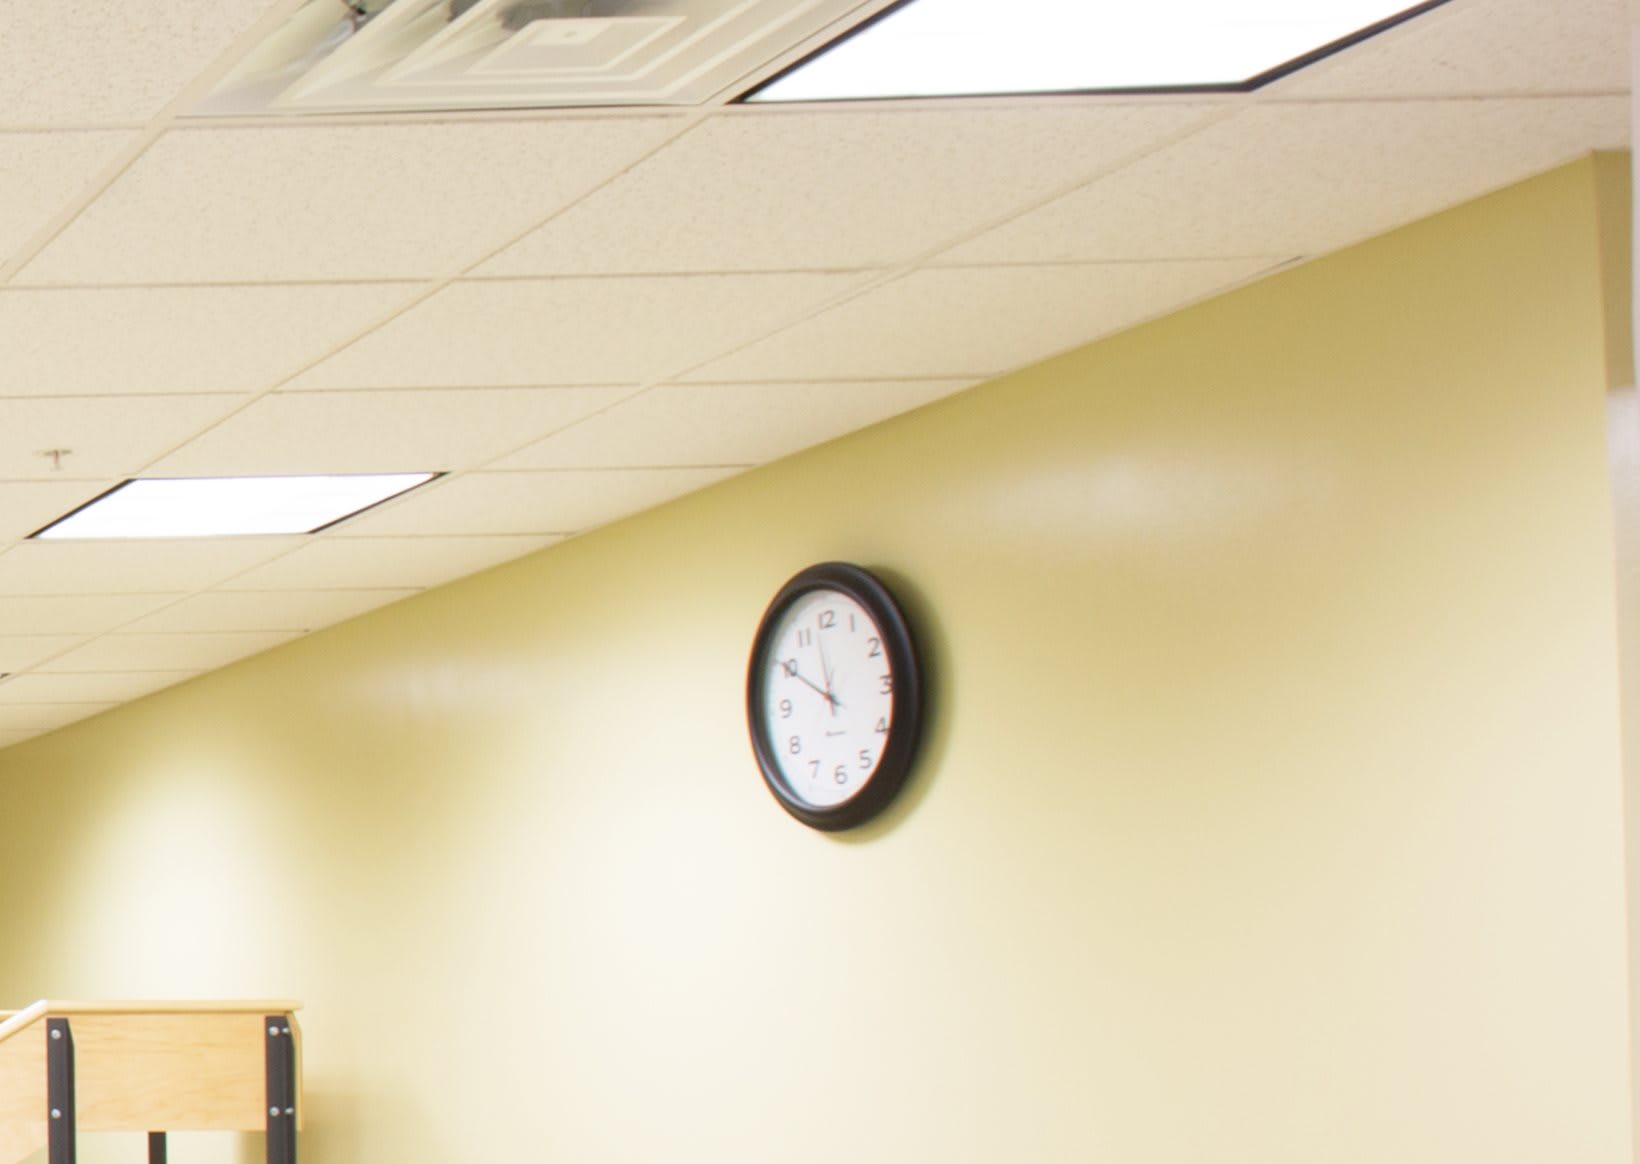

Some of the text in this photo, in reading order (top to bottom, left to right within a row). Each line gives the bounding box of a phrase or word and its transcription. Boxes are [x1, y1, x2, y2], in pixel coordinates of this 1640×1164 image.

[818, 610, 836, 629] 12
[797, 628, 811, 648] 11
[868, 637, 881, 658] 2
[784, 659, 799, 678] 10
[880, 674, 893, 695] 3
[779, 699, 793, 719] 9
[875, 716, 889, 735] 4
[789, 736, 801, 755] 8
[859, 749, 872, 769] 5
[808, 760, 821, 779] 7
[834, 765, 848, 785] 6
